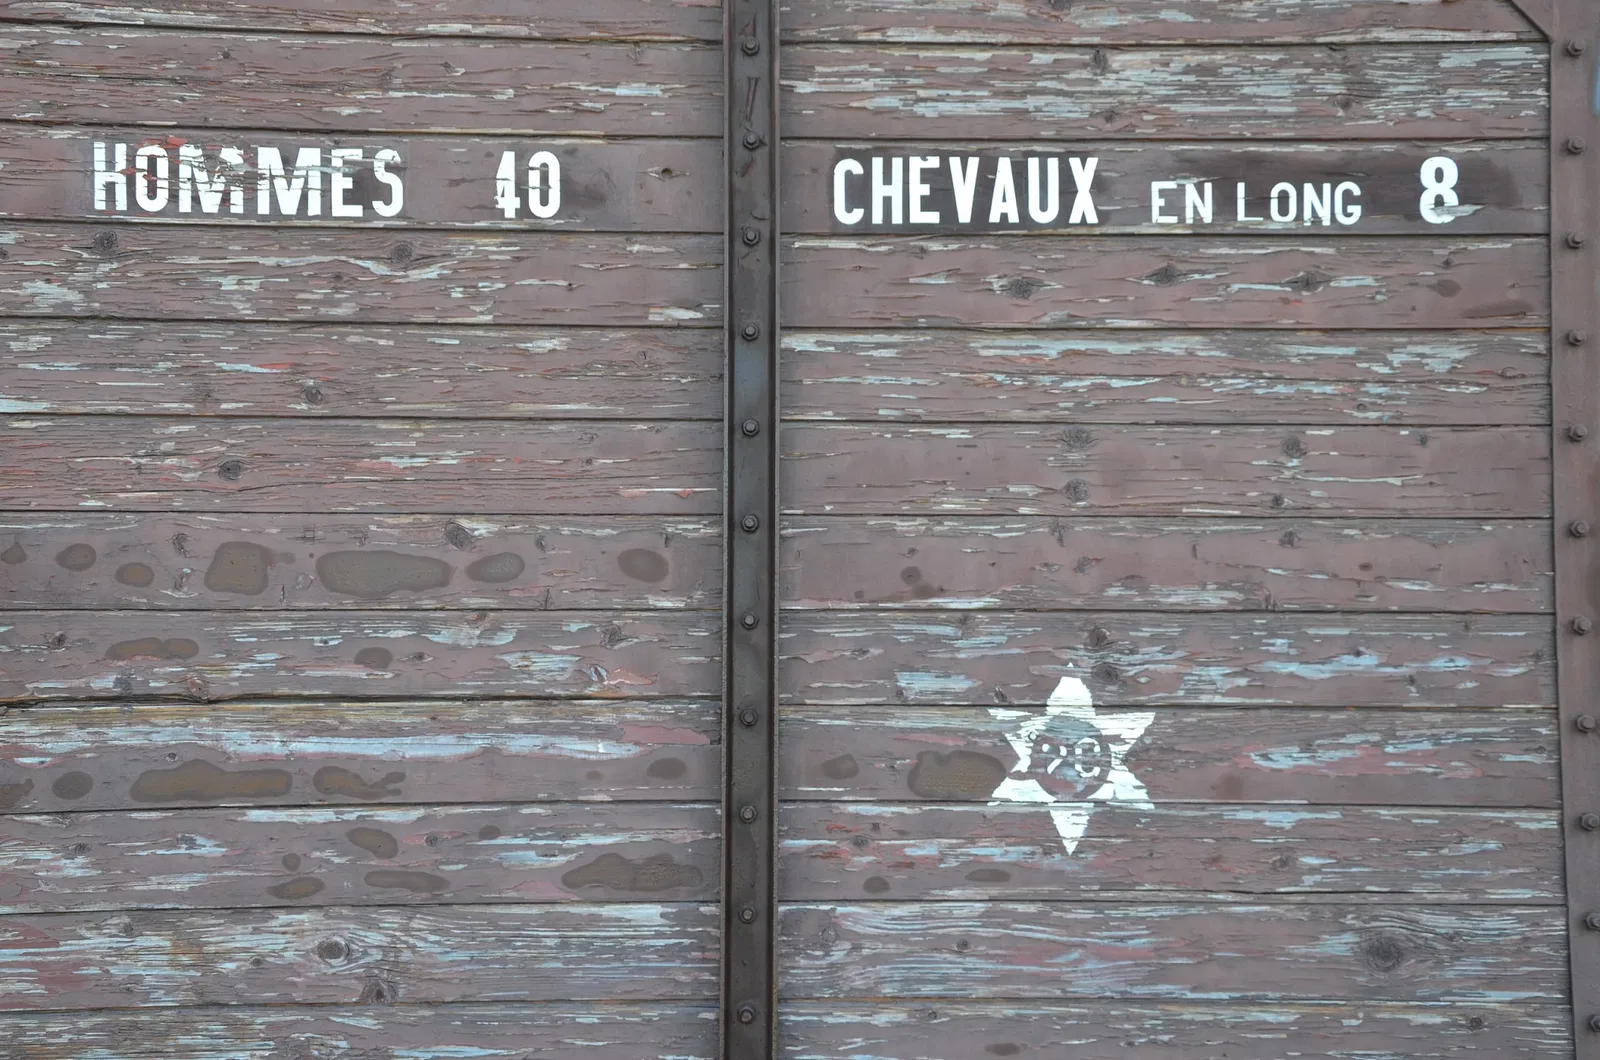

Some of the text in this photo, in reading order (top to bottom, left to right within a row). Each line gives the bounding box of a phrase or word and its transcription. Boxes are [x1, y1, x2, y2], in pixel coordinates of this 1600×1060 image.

[94, 141, 561, 218] HOMMES 40
[833, 156, 1461, 227] CHEVAUX EN LONG 8
